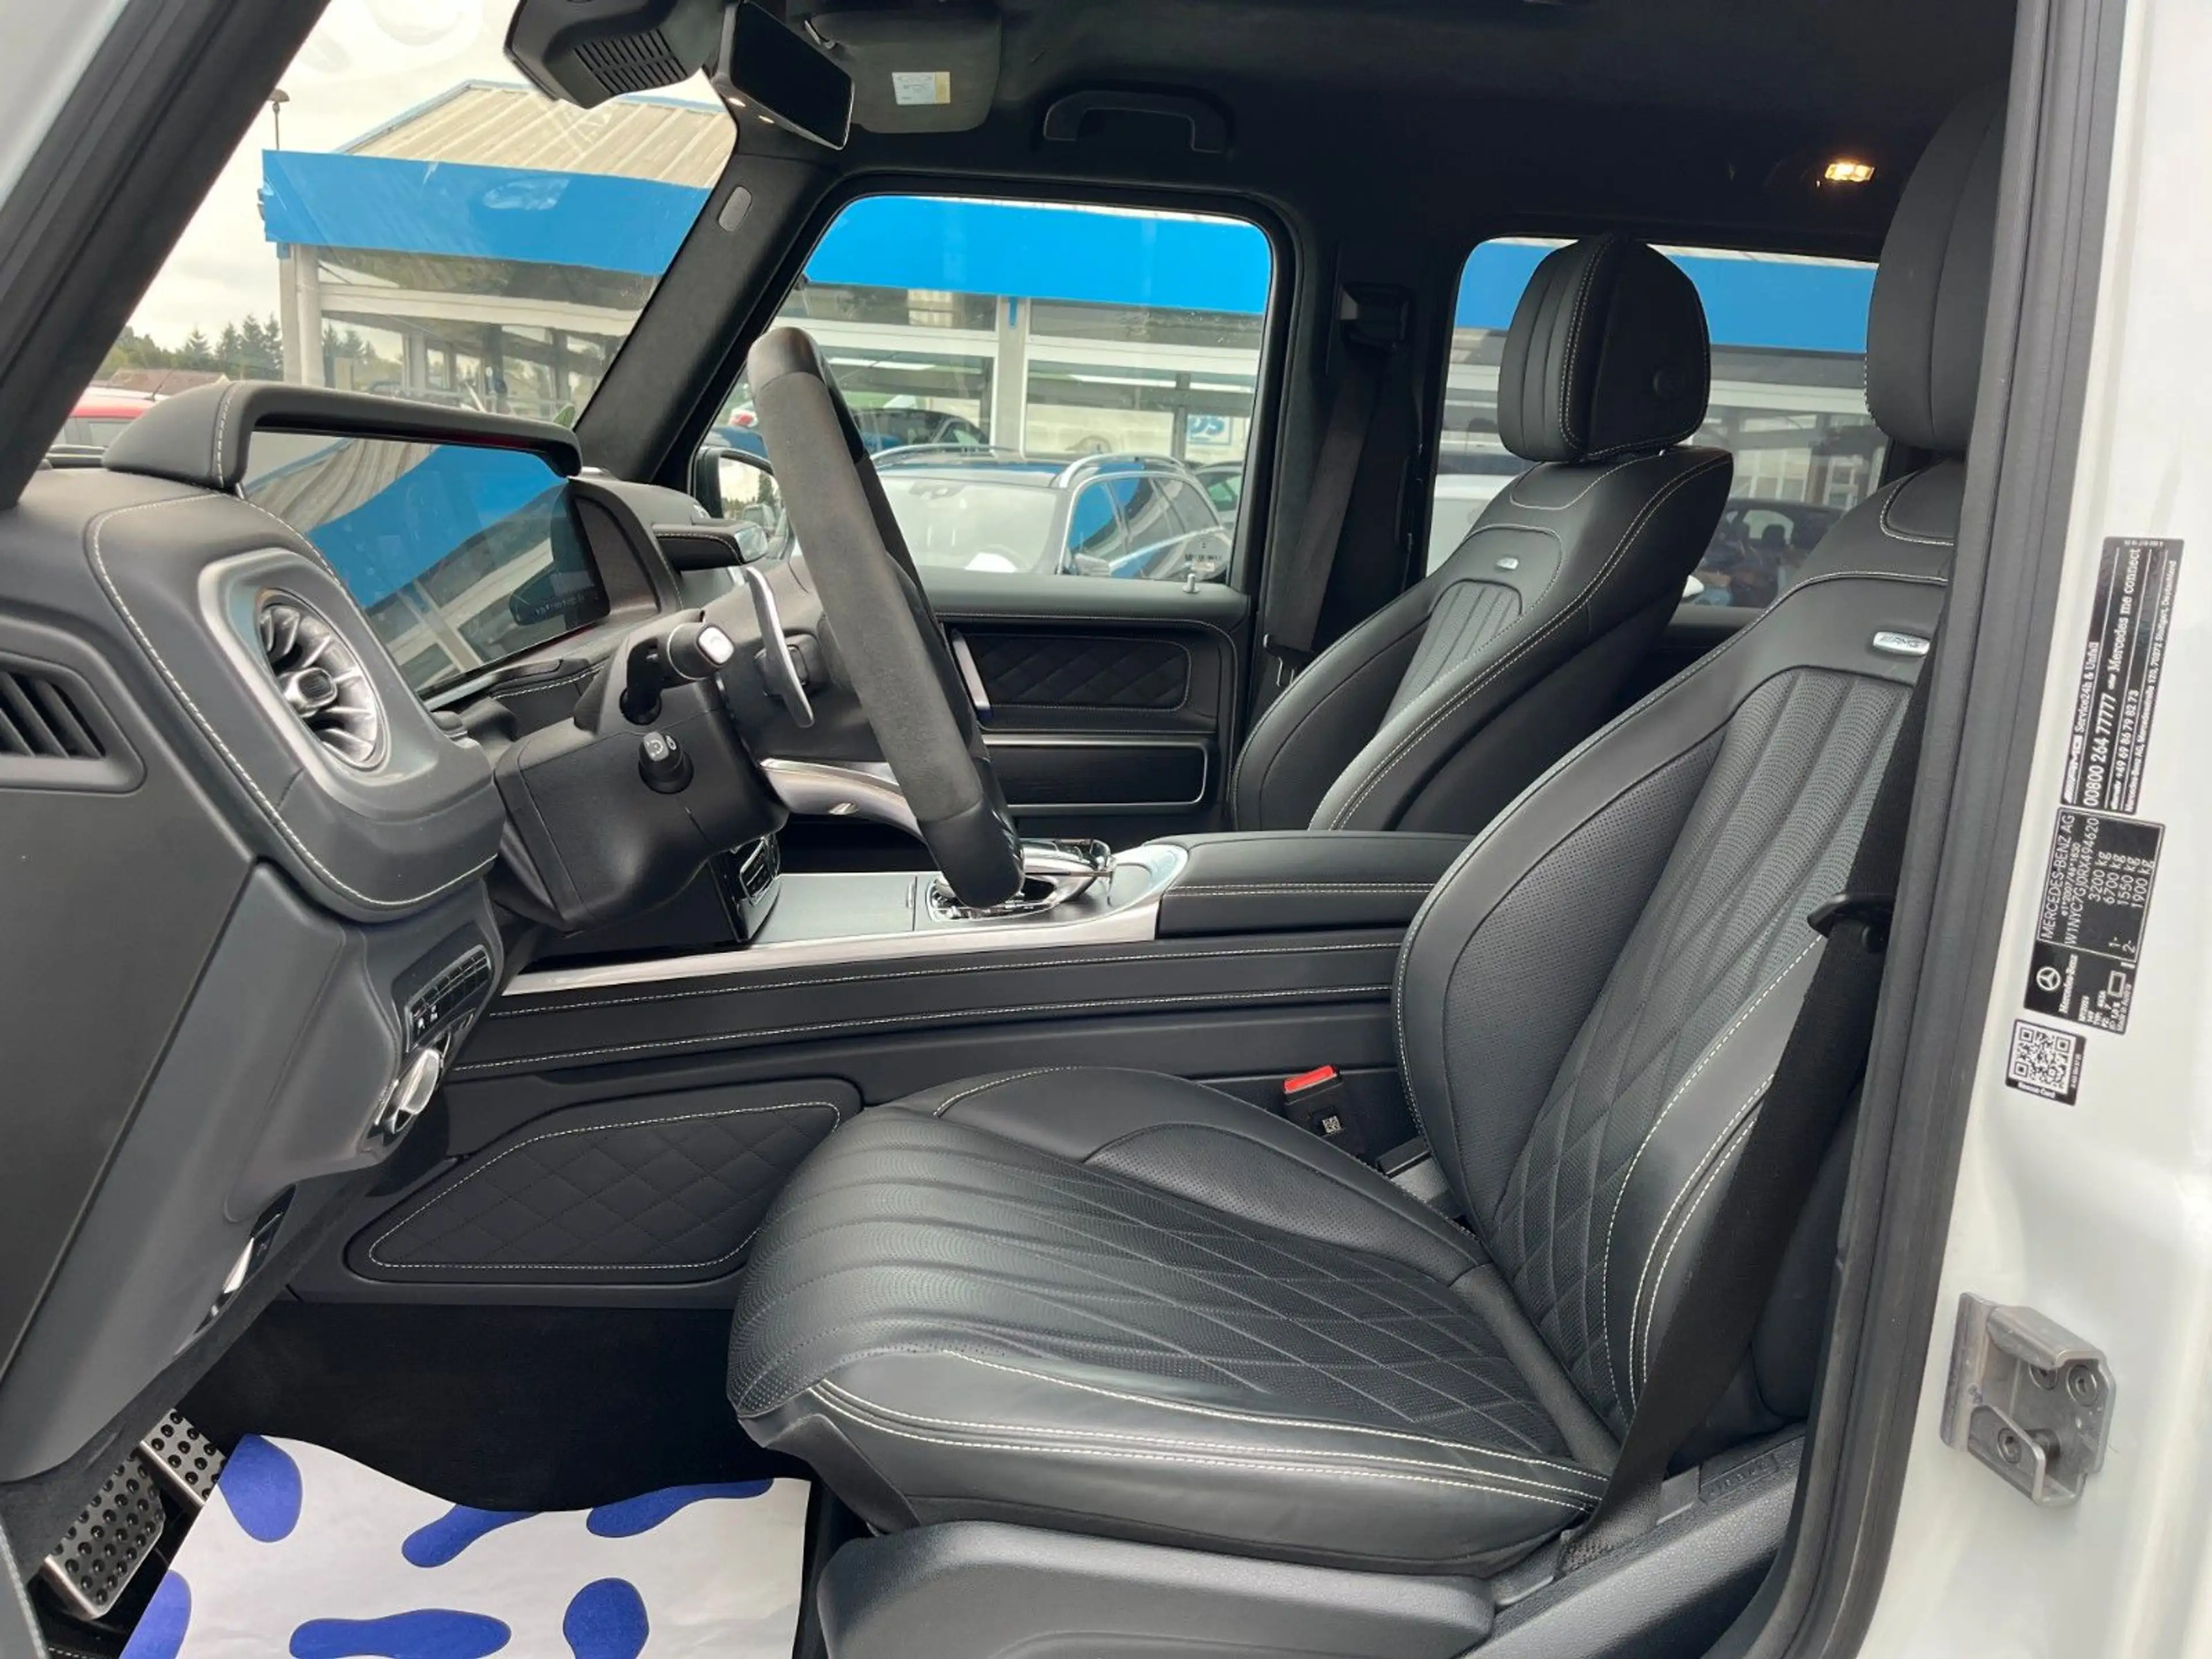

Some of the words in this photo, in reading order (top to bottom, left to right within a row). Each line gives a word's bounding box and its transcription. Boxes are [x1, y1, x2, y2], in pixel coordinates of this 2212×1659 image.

[2123, 548, 2141, 594] connect
[2118, 596, 2133, 615] me
[2107, 616, 2129, 672] Mercedes
[2083, 671, 2094, 680] &
[2125, 703, 2137, 717] 82
[2127, 688, 2139, 703] 73
[2094, 692, 2117, 735] 77777
[2123, 718, 2134, 731] 79
[2090, 736, 2110, 763] 264
[2082, 764, 2105, 807] 00800
[2094, 850, 2112, 867] kg
[2108, 853, 2126, 869] kg
[2123, 855, 2141, 872] kg
[2137, 858, 2155, 875] kg
[2040, 835, 2071, 938] MERCEDES-BENZ
[2059, 814, 2075, 834] AG
[2088, 868, 2105, 902] 3200
[2102, 871, 2119, 905] 6700
[2116, 874, 2134, 907] 1550
[2130, 877, 2148, 909] 1900
[2058, 955, 2079, 1013] Mercedes-Benz
